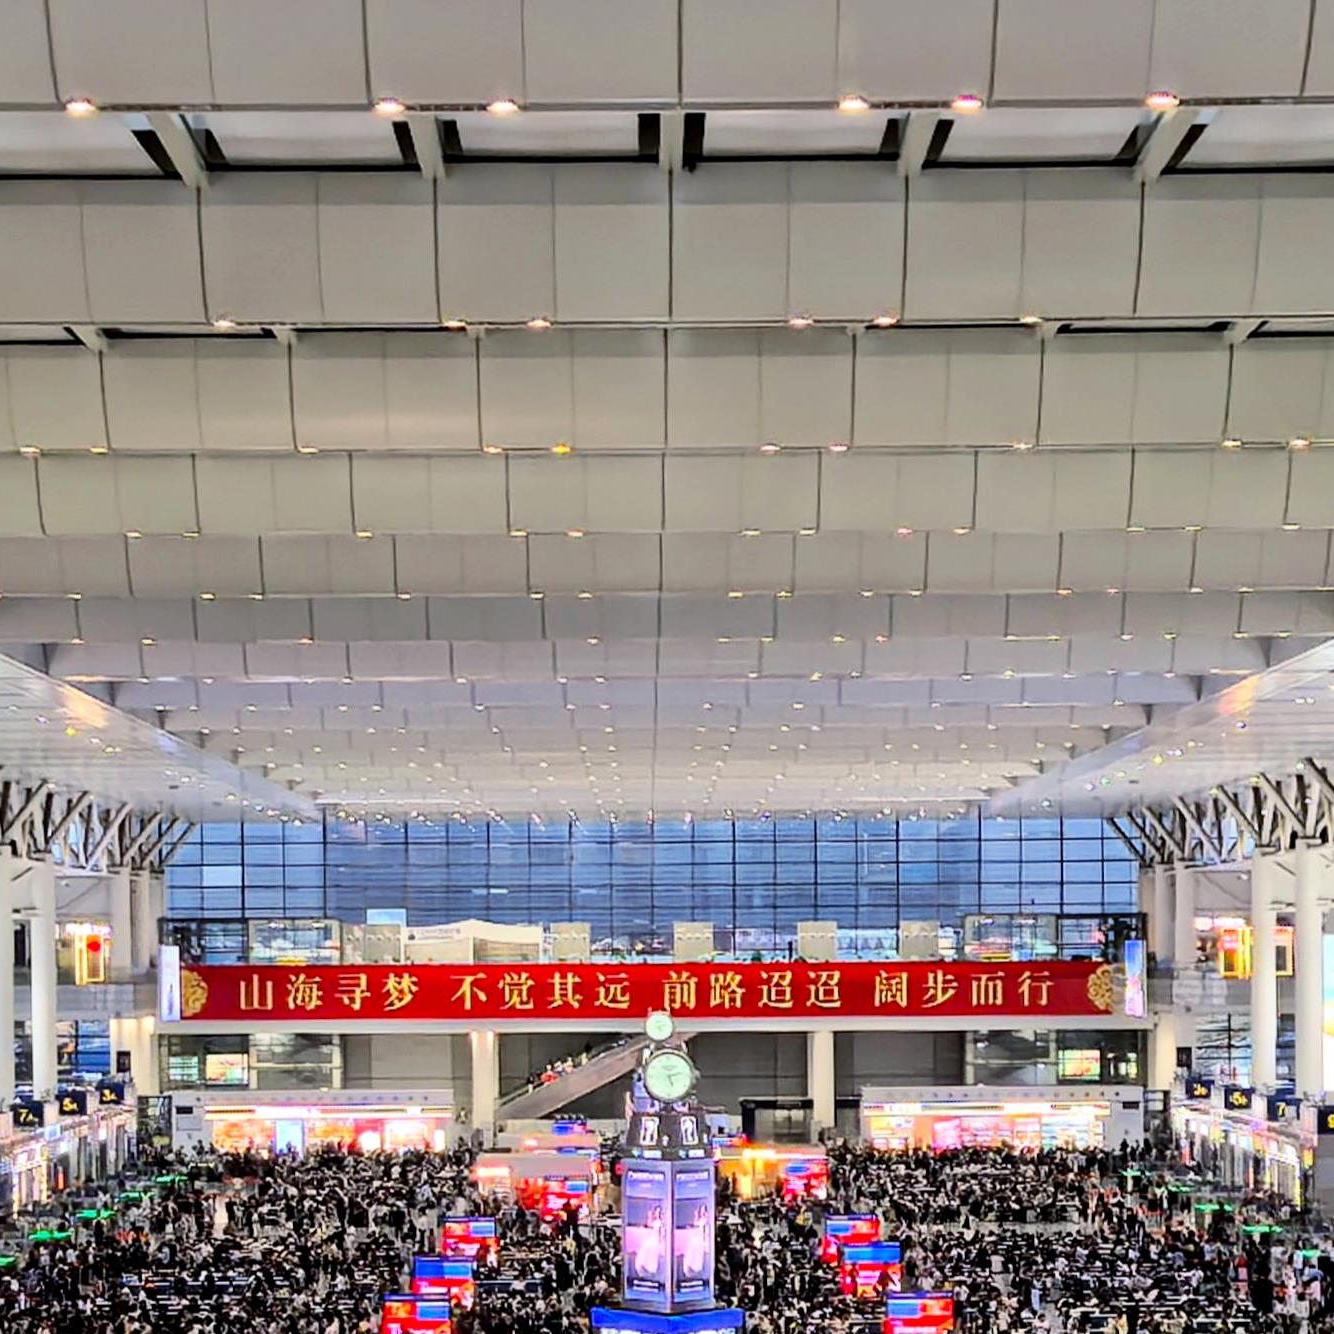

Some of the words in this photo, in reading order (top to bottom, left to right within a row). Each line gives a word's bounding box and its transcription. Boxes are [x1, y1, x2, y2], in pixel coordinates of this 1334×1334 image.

[241, 973, 418, 1010] 山海寻梦
[452, 972, 630, 1010] 不觉其远
[663, 970, 841, 1010] 前路迢迢
[874, 969, 1054, 1008] 阔步而行
